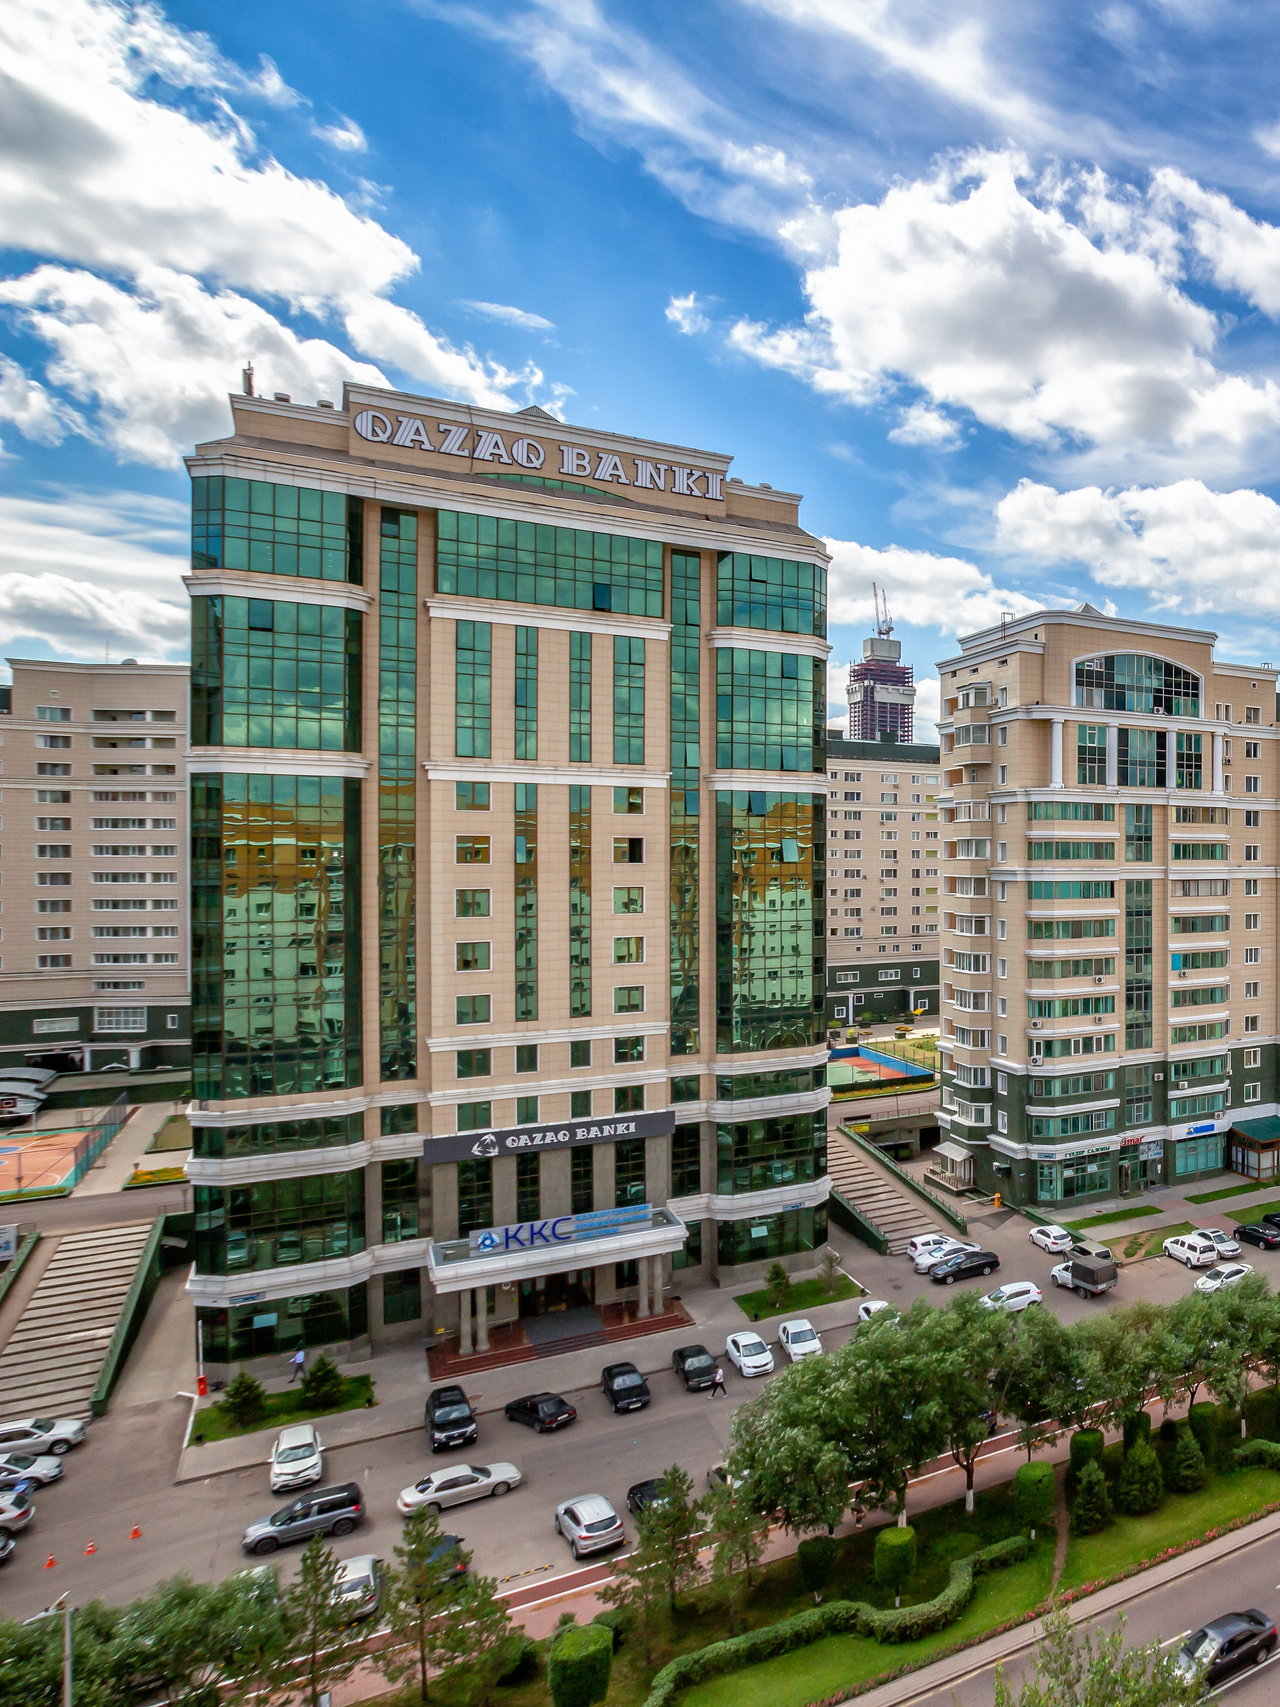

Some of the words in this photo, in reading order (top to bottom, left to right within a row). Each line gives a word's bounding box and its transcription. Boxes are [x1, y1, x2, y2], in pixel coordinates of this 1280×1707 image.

[354, 409, 545, 469] QAZAQ
[558, 444, 725, 501] BANKI
[505, 1131, 570, 1148] QAZAQ
[575, 1122, 636, 1140] BANKI
